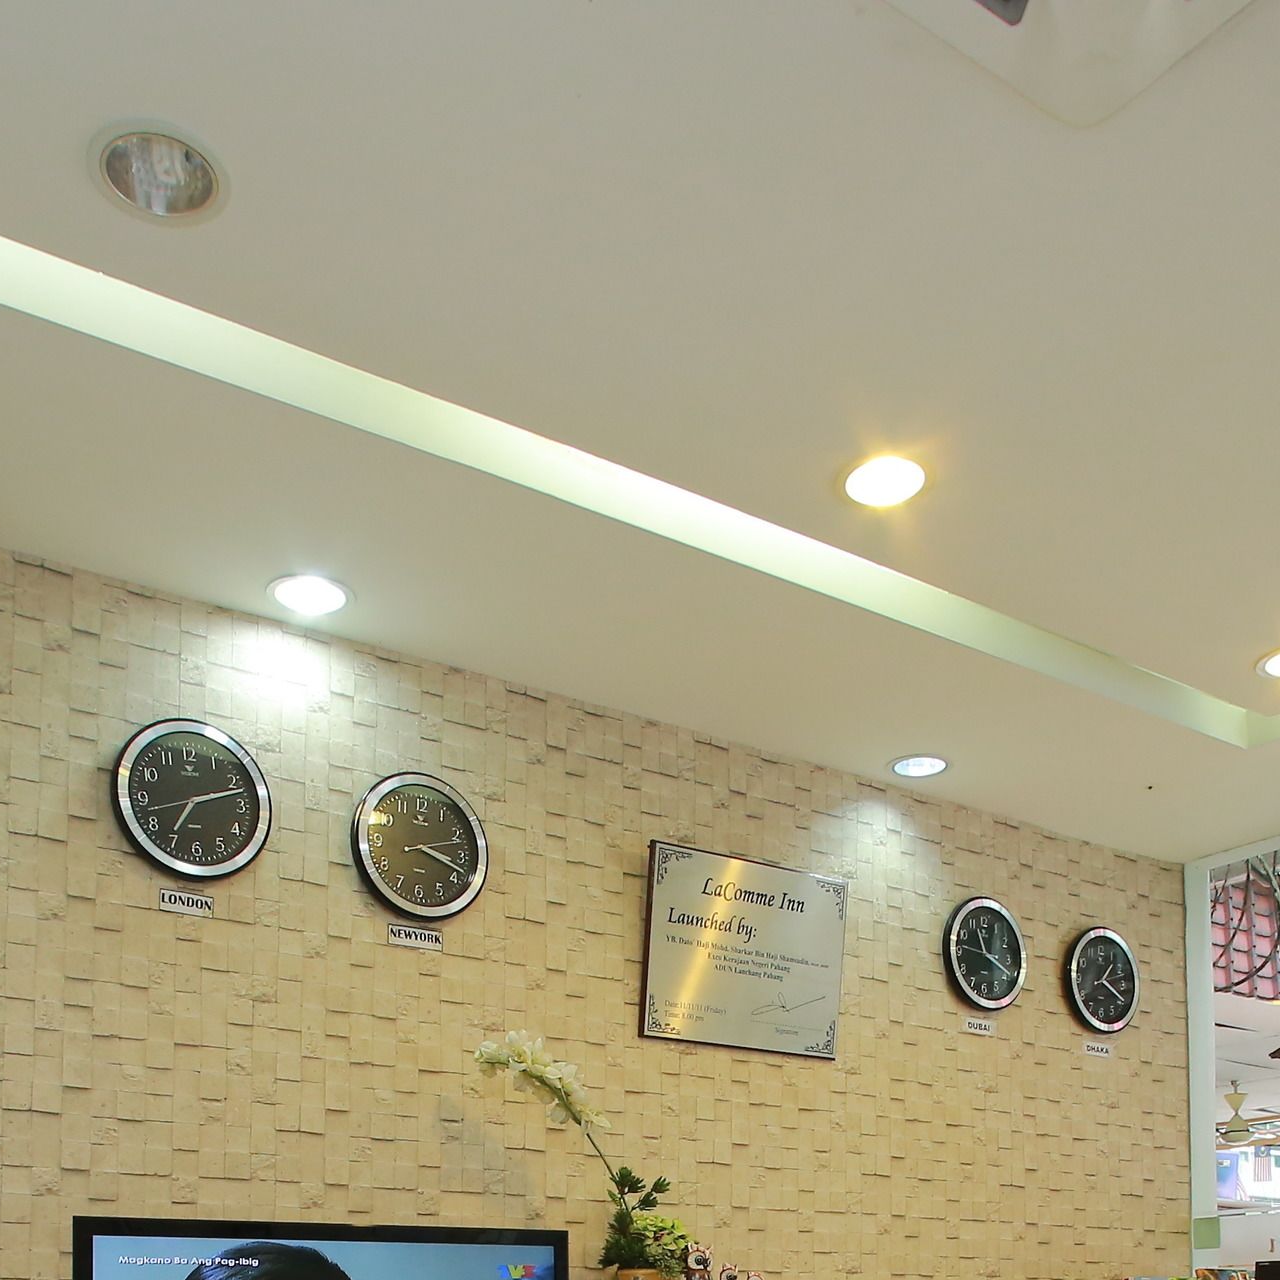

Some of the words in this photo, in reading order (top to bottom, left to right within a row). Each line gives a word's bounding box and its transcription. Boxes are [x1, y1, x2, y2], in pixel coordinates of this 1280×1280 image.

[161, 751, 173, 765] 11
[182, 747, 197, 761] 12
[144, 767, 158, 782] 10
[227, 774, 237, 789] 2
[137, 791, 148, 806] 9
[236, 798, 246, 813] 3
[416, 798, 428, 813] 12
[397, 799, 407, 814] 11
[148, 816, 159, 831] 8
[381, 813, 393, 827] 10
[230, 822, 240, 836] 4
[452, 828, 460, 841] 2
[168, 834, 179, 849] 7
[215, 837, 225, 852] 5
[373, 833, 382, 847] 9
[191, 841, 202, 857] 6
[380, 856, 389, 871] 8
[457, 850, 465, 864] 3
[396, 874, 405, 888] 7
[449, 871, 458, 884] 4
[414, 885, 423, 898] 6
[435, 882, 444, 896] 5
[701, 877, 776, 908] LaComme
[778, 892, 806, 914] Inn
[161, 892, 213, 911] LONDON
[667, 906, 736, 934] Launched
[736, 917, 758, 944] by:
[389, 927, 443, 945] NEWYORK
[967, 1021, 991, 1032] DUBAI
[1086, 1044, 1109, 1054] DHAKA
[118, 1256, 171, 1267] Magkano
[174, 1256, 188, 1265] Ba
[190, 1257, 212, 1267] Ang
[215, 1257, 259, 1267] Pag-Ibig
